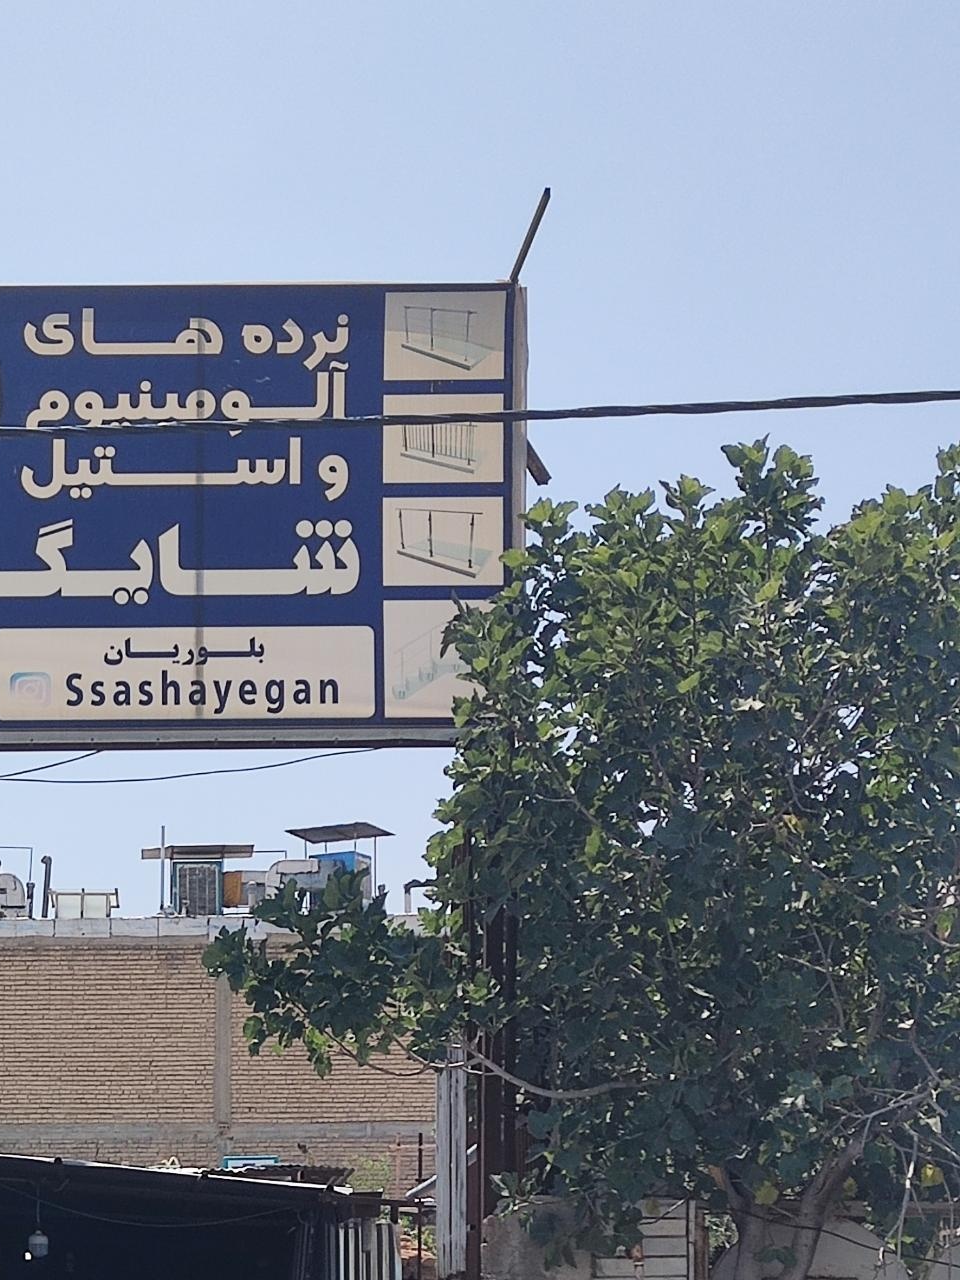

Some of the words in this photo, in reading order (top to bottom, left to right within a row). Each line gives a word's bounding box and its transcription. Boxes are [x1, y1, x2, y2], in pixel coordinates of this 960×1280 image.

[23, 307, 224, 356] های
[242, 313, 350, 370] نرده
[25, 361, 349, 437] آلومینیوم
[20, 436, 301, 499] استیل
[318, 454, 349, 501] و
[103, 636, 266, 666] بلوریان
[65, 670, 340, 715] Ssashayegan
